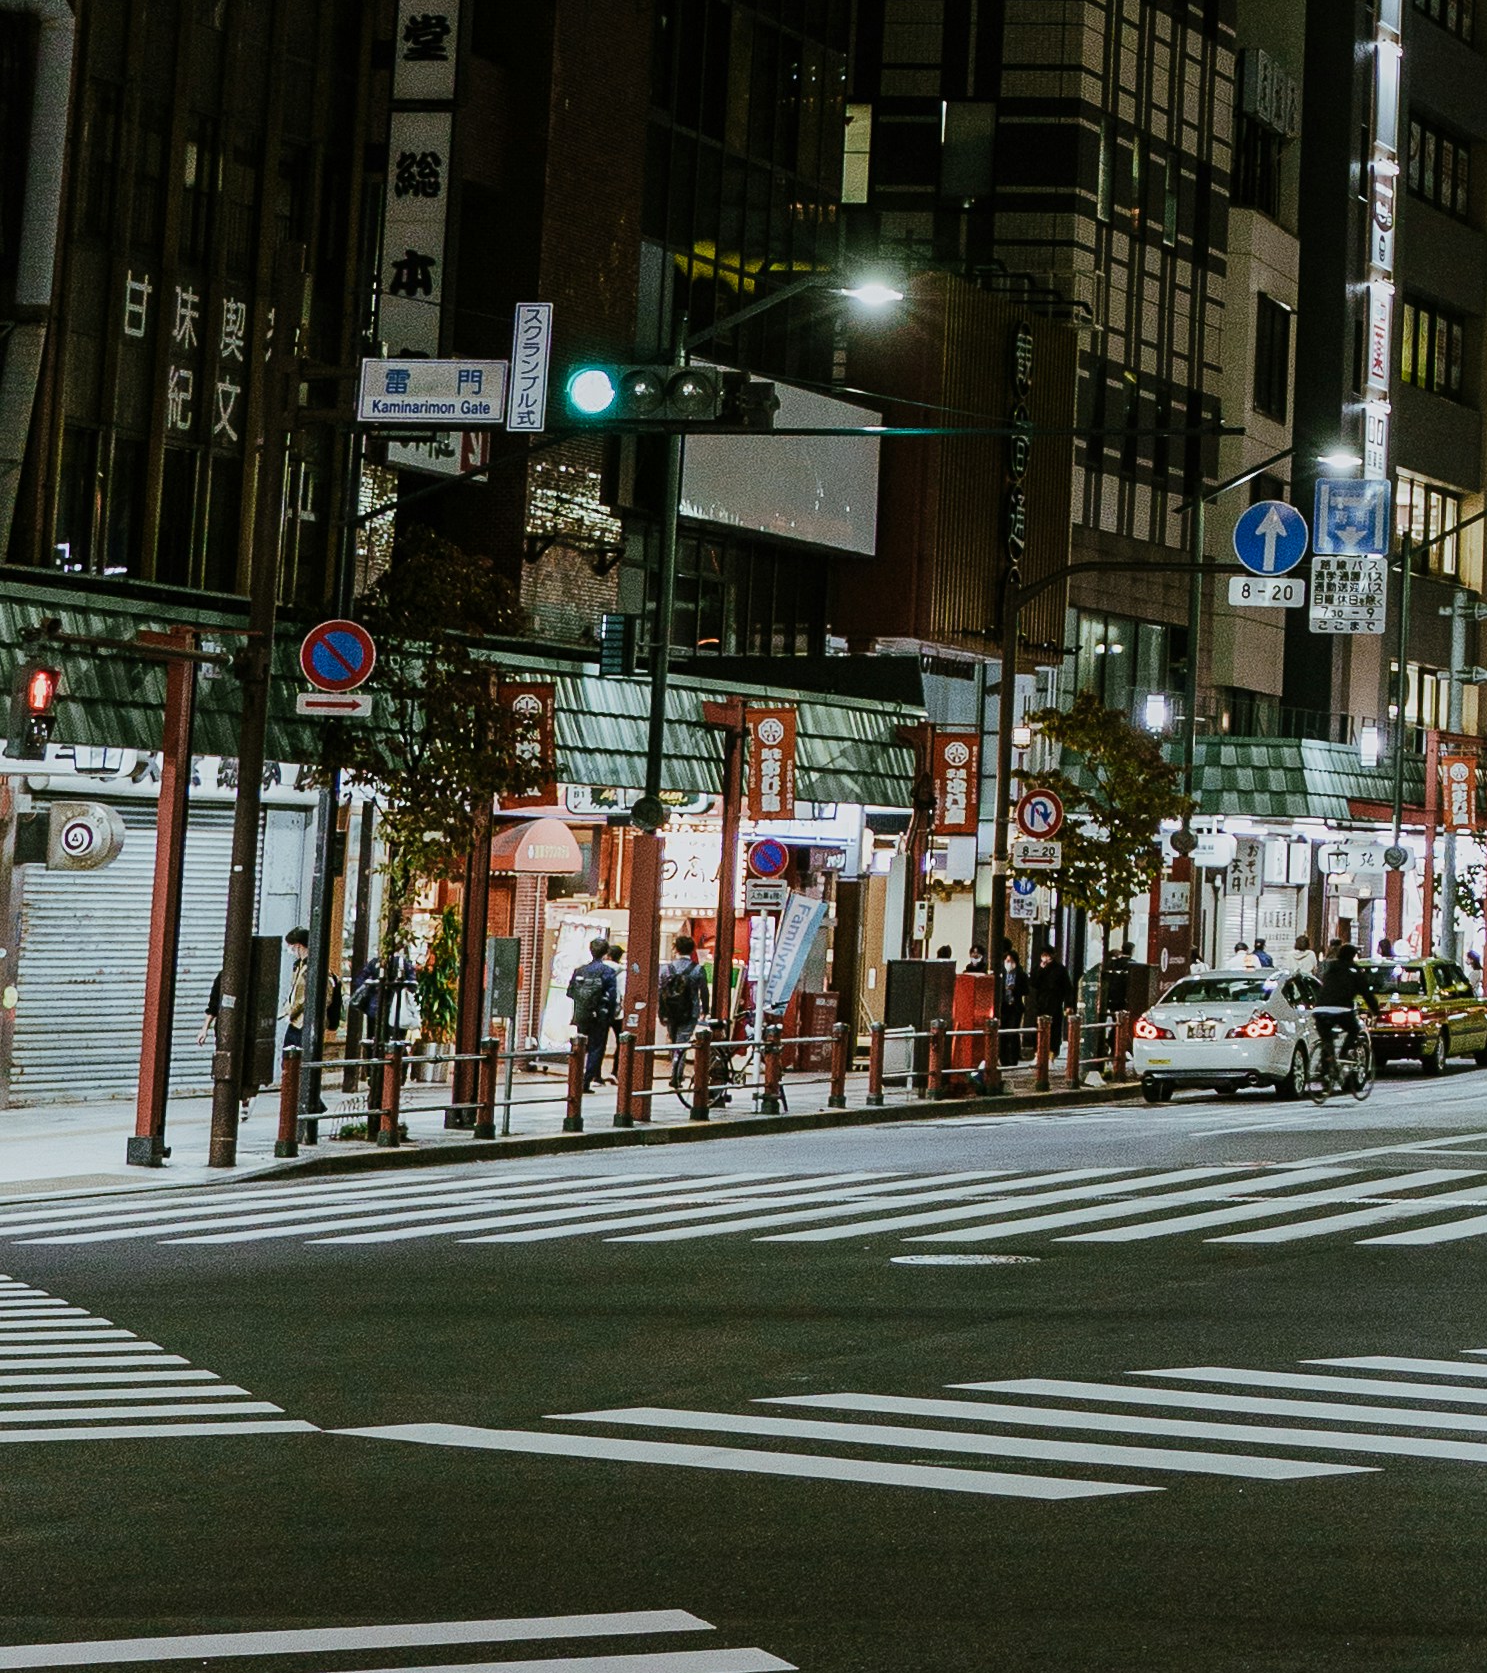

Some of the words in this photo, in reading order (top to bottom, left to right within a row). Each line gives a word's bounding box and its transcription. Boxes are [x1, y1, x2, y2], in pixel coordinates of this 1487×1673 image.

[124, 268, 275, 362] 甘味喫
[516, 308, 543, 426] スクランブル式
[385, 369, 483, 395] 雷門
[372, 399, 455, 414] Kaminarimon
[461, 400, 491, 414] Gate
[1320, 559, 1378, 571] 路線バス
[1317, 620, 1376, 631] ここまで
